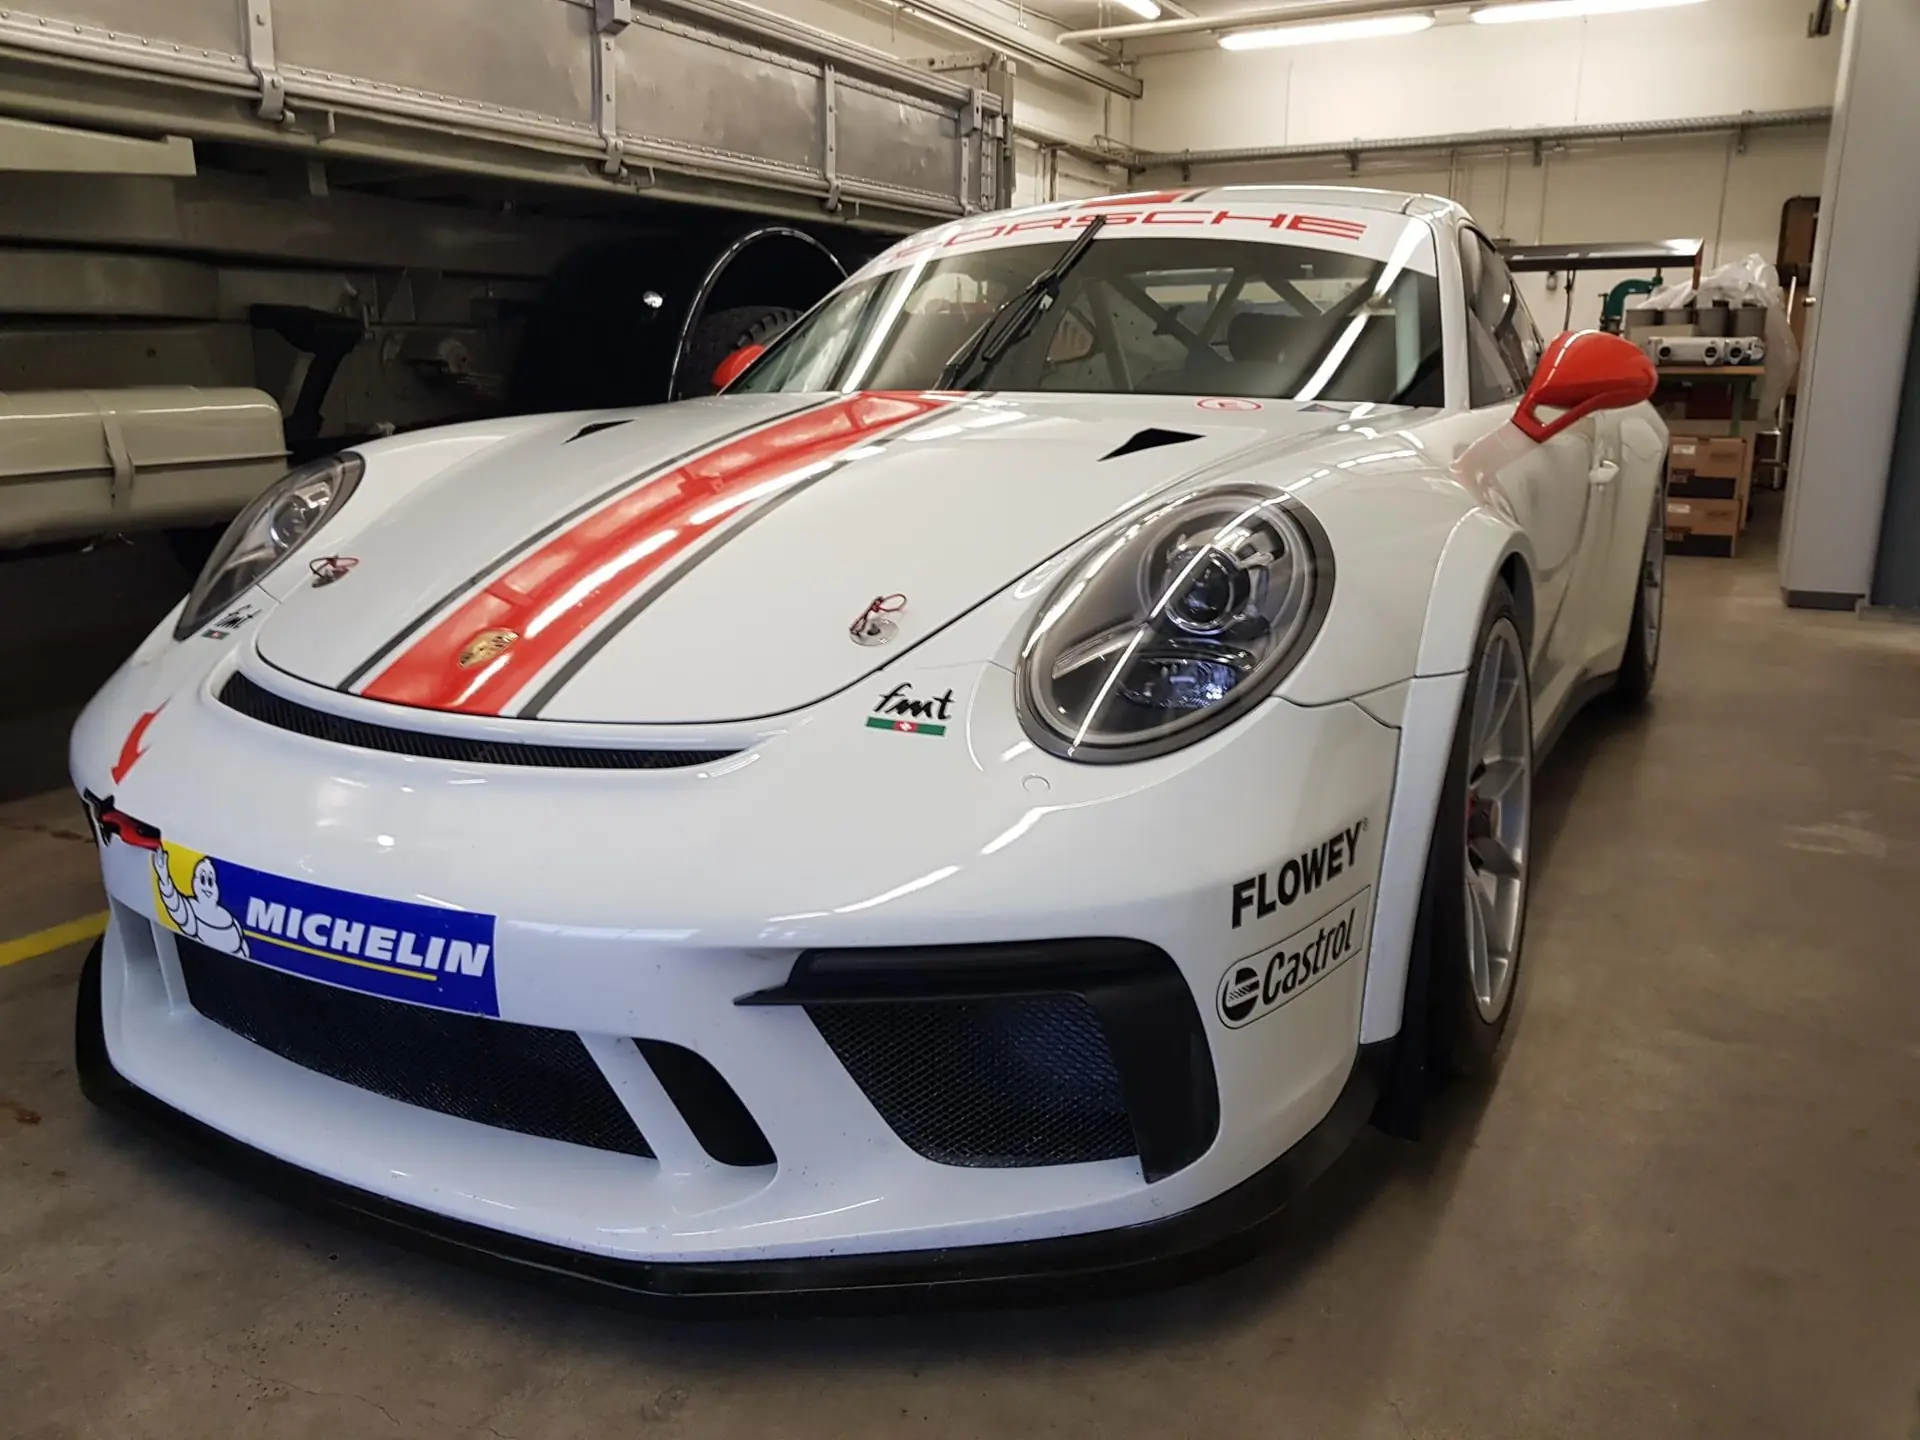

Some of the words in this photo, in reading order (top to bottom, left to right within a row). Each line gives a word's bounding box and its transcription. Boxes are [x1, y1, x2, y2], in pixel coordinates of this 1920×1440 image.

[873, 682, 956, 719] fmt
[1231, 820, 1364, 930] FLOWEY
[246, 896, 490, 977] MICHELIN
[1261, 907, 1356, 1006] Castrol
